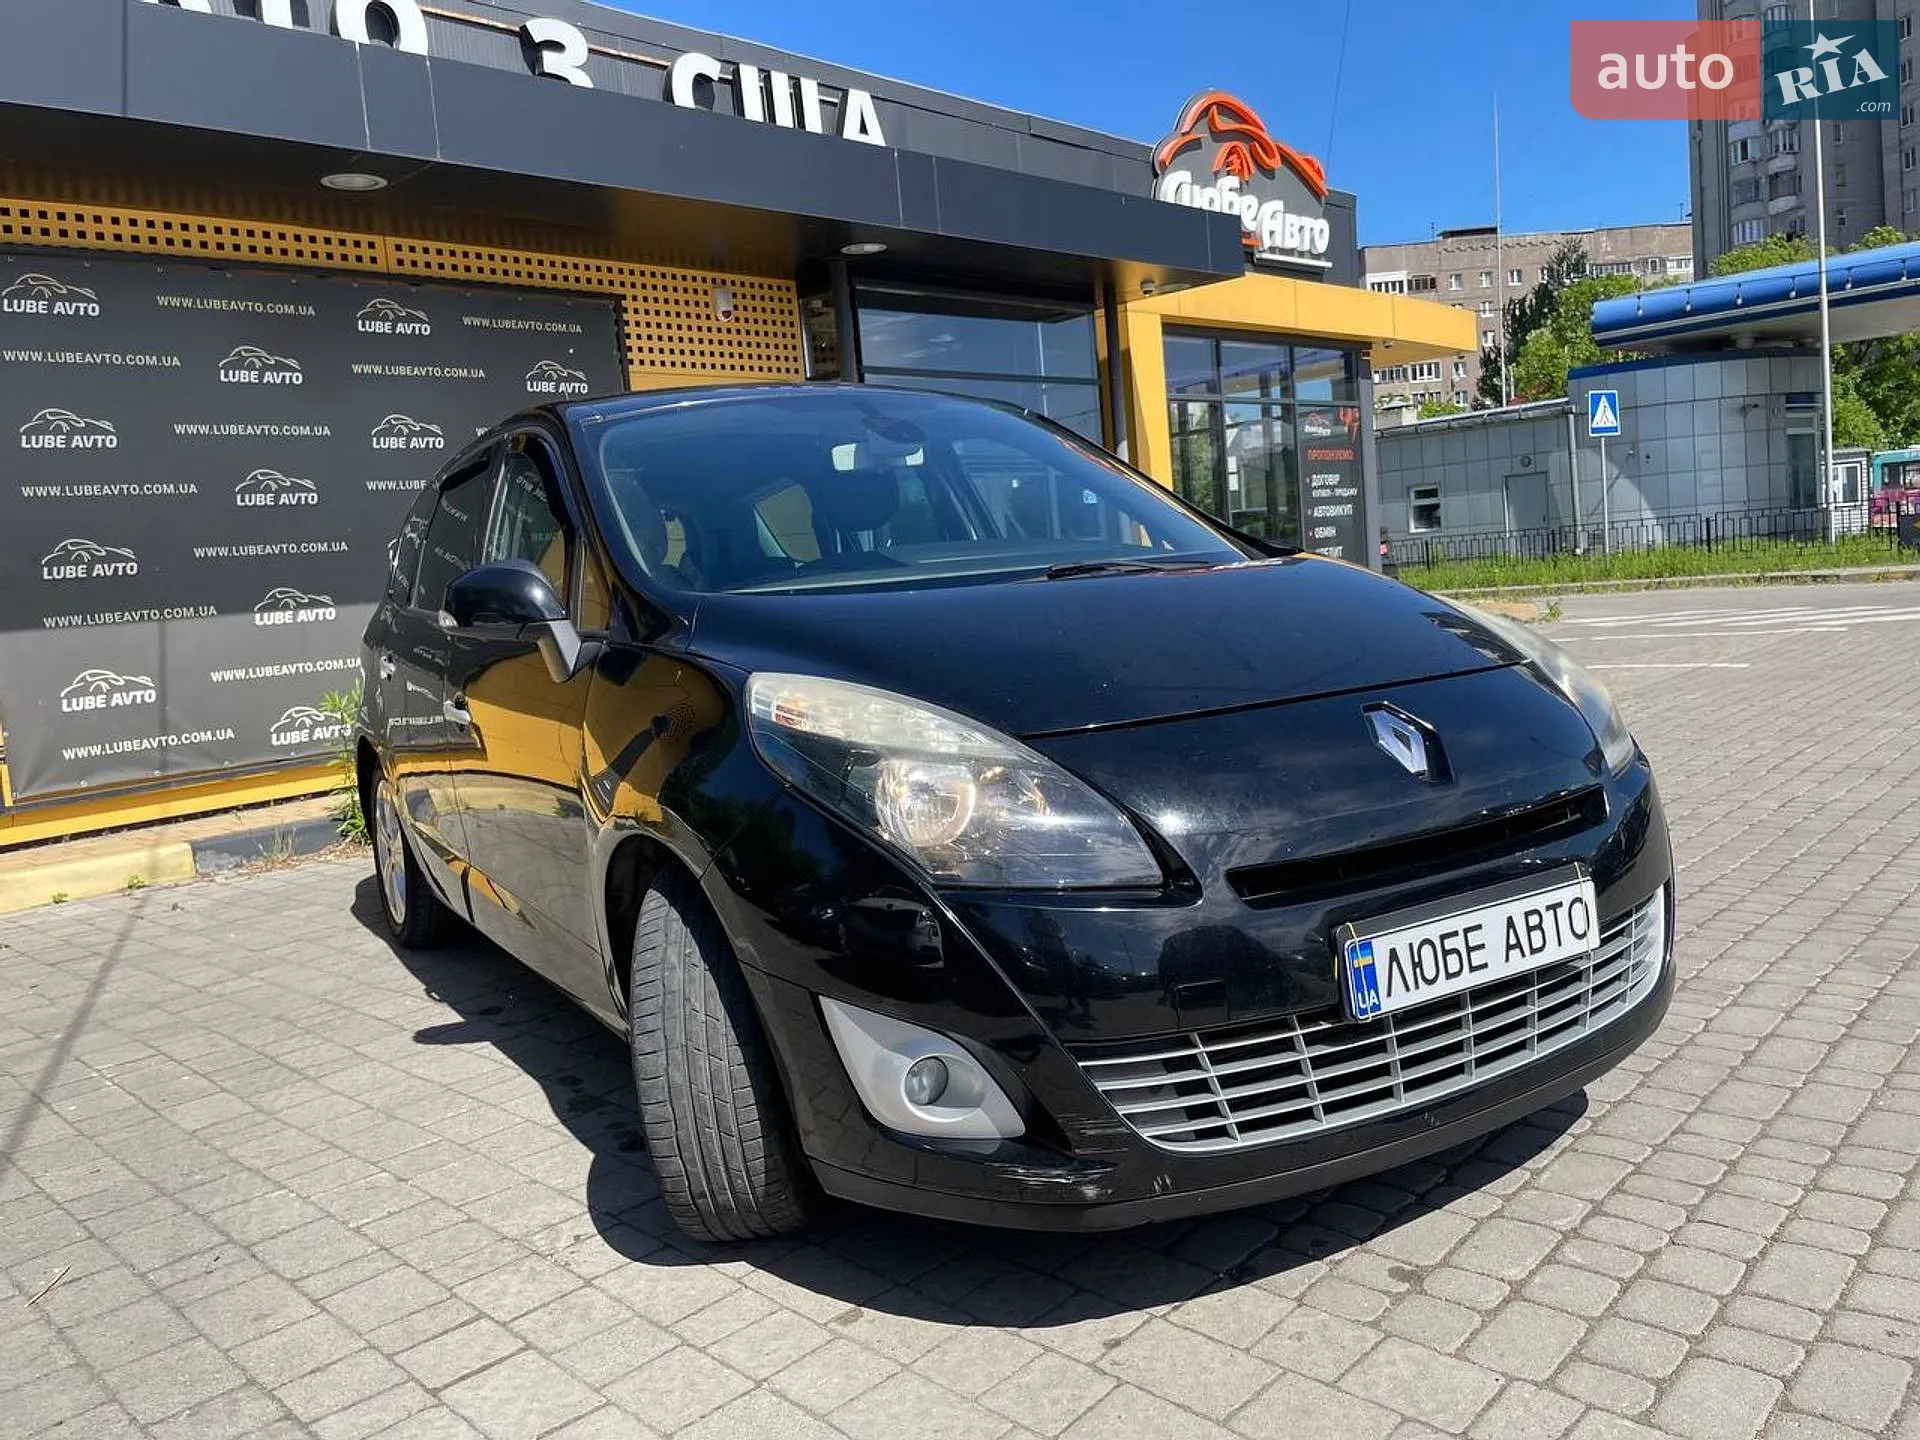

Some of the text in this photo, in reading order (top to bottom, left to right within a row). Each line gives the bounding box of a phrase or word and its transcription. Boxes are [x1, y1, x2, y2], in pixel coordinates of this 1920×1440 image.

[2, 299, 100, 317] LUBE AVTO
[156, 295, 316, 317] WWW.LUBEAVTO.COM.UA
[357, 319, 431, 336] LUBE AVTO
[462, 315, 582, 334] WWW.LUBEAVTO.COM.UA
[2, 349, 182, 368] WWW.LUBEAVTO.COM.UA
[219, 368, 303, 385] LUBE AVTO
[351, 363, 486, 379] WWW.LUBEAVTO.COM.UA
[526, 380, 589, 395] LUBE AVTO
[173, 423, 331, 438] WWW.LUBEAVTO.COM.UA
[20, 434, 118, 449] LUBE AVTO
[371, 436, 445, 450] LUBE AVTO
[21, 482, 198, 497] WWW.LUBEAVTO.COM.UA
[236, 492, 318, 507] LUBE AVTO
[193, 541, 349, 558] WWW.LUBEAVTO.COM.UA
[42, 562, 138, 580] LUBE AVTO
[43, 605, 218, 629] WWW.LUBEAVTO.COM.UA
[254, 607, 337, 626] LUBE AVTO
[61, 689, 157, 713] LUBE AVTO
[62, 727, 235, 761] WWW.LUBEAVTO.COM.UA
[271, 732, 311, 747] LUBE
[1387, 896, 1591, 998] ЛЮБЕ АВТО
[1358, 988, 1380, 1009] UA
